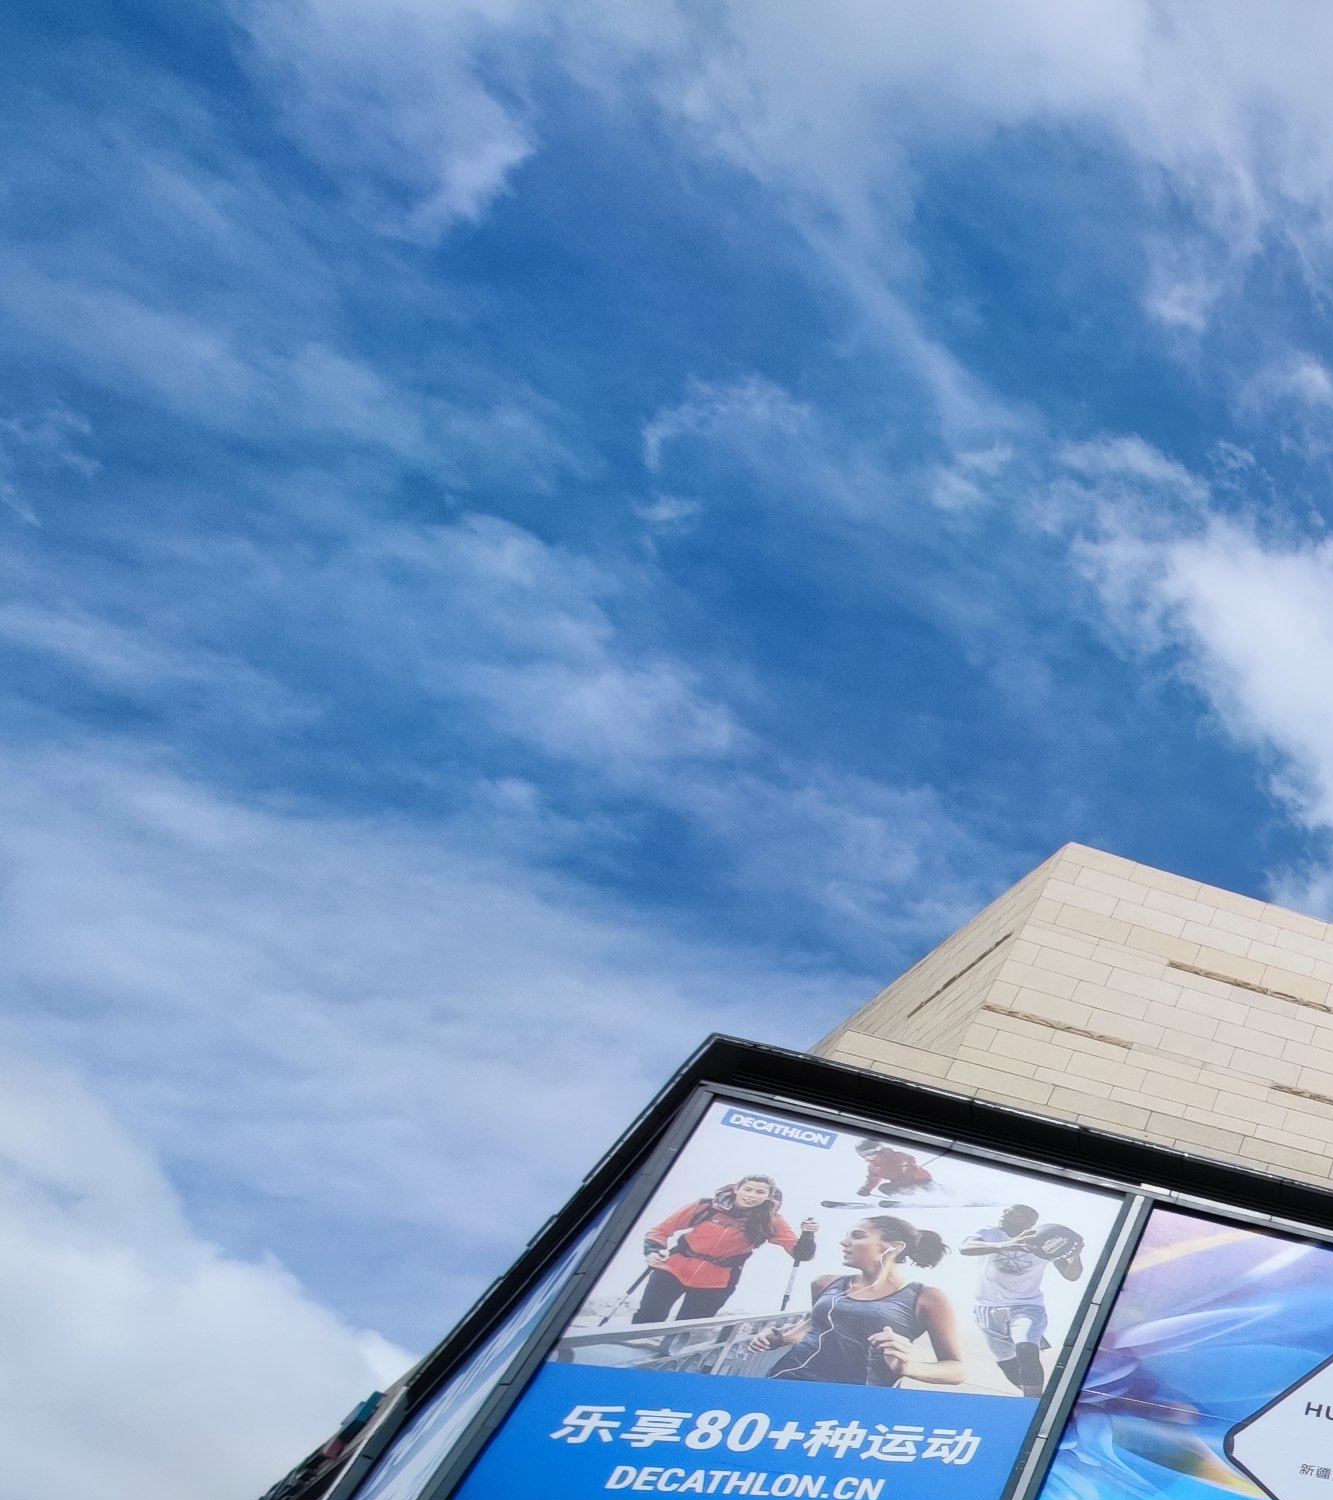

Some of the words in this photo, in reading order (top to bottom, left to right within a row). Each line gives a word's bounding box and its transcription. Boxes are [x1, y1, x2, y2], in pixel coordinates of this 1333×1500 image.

[729, 1113, 830, 1145] DECATHLON
[550, 1405, 982, 1466] 乐享80+种运动
